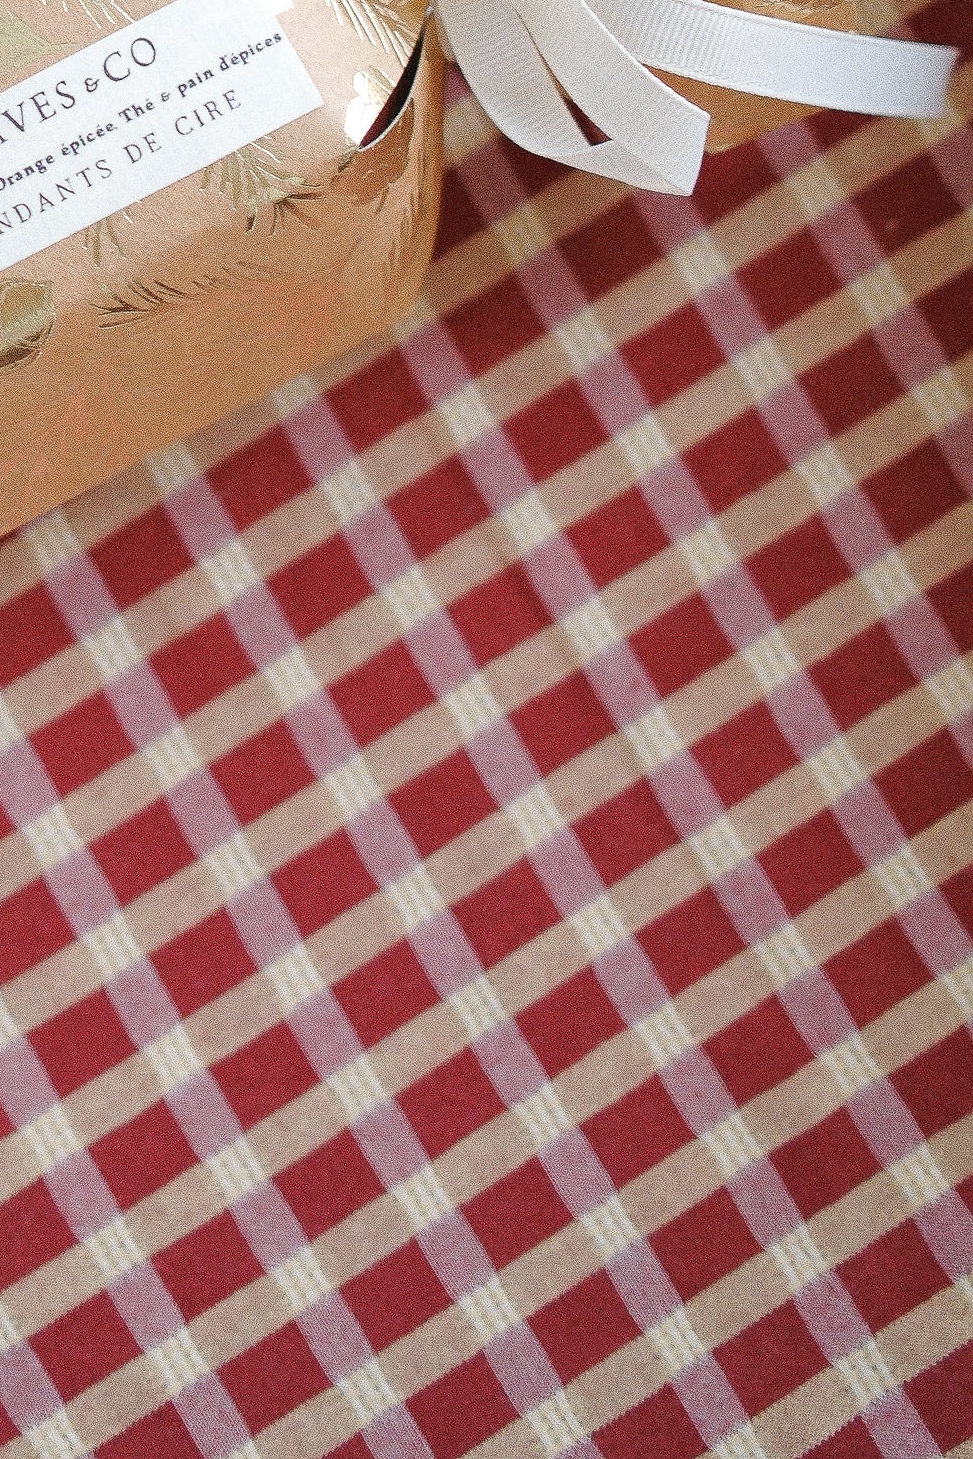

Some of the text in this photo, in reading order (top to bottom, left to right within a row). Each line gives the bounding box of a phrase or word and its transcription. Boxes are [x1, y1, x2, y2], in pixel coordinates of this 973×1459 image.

[117, 96, 156, 124] Thé
[160, 91, 171, 103] &
[176, 68, 216, 99] pain
[218, 32, 283, 72] d'épices
[122, 131, 163, 165] DE
[174, 88, 242, 136] CIRE
